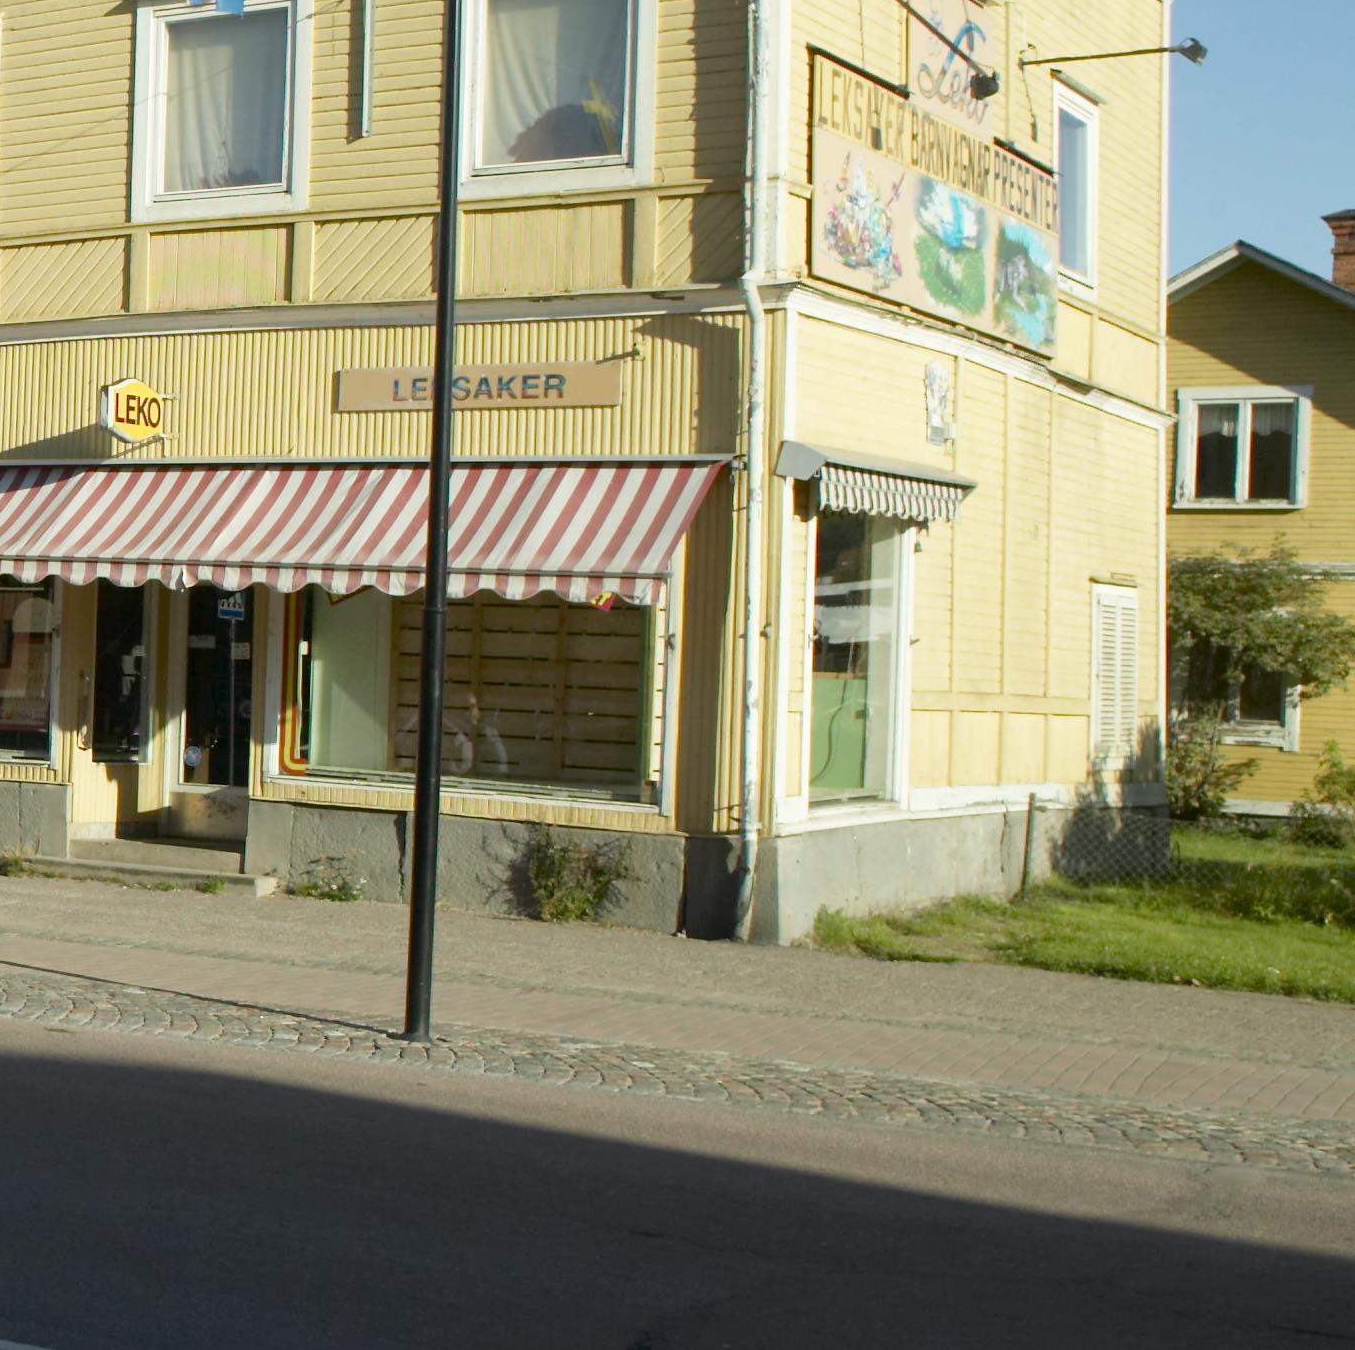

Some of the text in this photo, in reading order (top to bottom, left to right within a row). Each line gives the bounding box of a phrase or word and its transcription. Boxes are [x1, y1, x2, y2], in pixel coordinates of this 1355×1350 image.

[910, 105, 990, 203] BARNVAGNAR
[993, 149, 1058, 234] PRESENTER
[392, 373, 567, 402] LESAKER
[114, 393, 161, 429] LEKO
